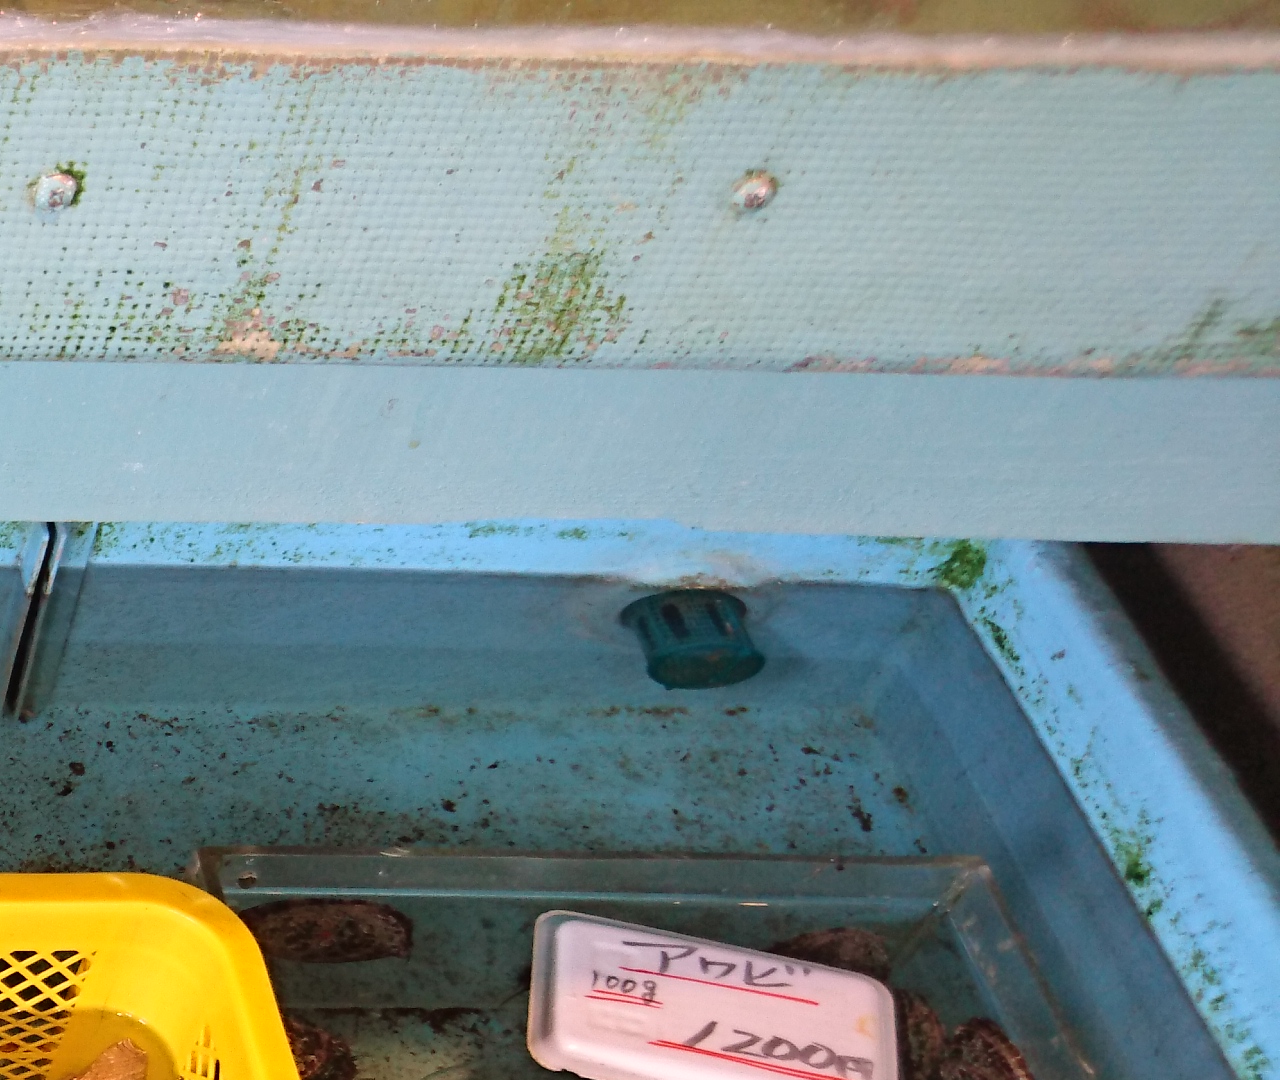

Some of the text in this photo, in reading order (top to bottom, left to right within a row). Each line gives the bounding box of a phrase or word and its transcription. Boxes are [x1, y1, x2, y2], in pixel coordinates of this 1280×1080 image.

[623, 941, 811, 988] アワビ
[592, 970, 657, 1004] 100g
